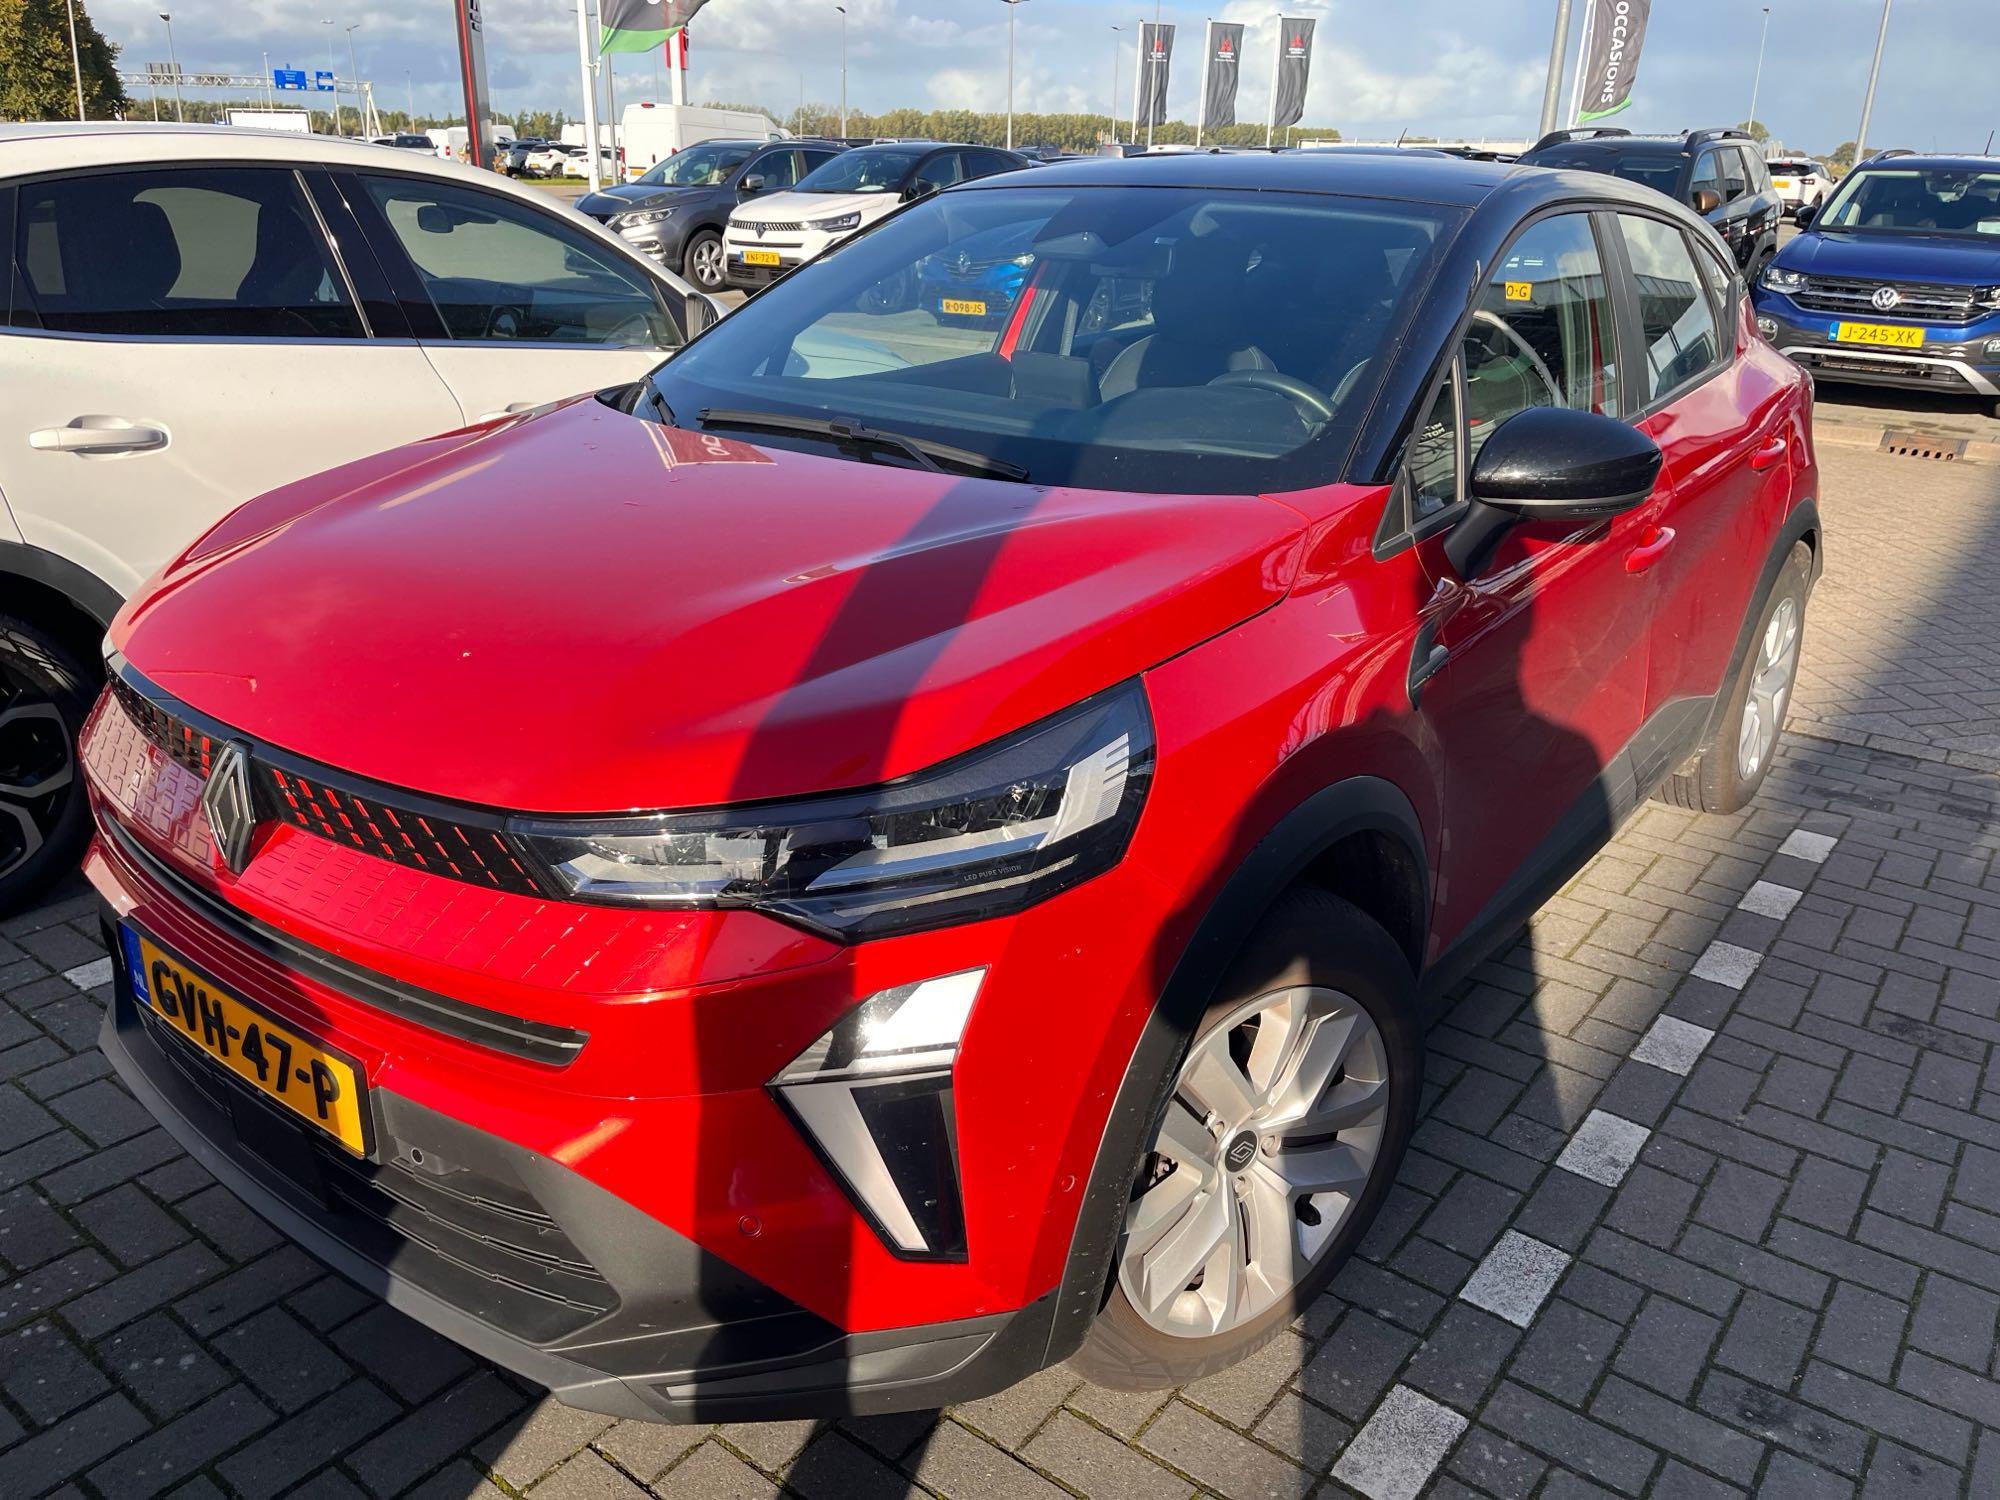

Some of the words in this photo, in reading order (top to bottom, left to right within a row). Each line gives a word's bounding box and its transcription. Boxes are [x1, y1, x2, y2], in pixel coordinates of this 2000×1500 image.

[1601, 1, 1630, 103] OCCASIONS
[944, 301, 983, 313] R-098-JS
[1844, 326, 1917, 344] J-245-XK
[963, 873, 978, 882] LED
[978, 869, 998, 879] PURE
[998, 865, 1022, 875] VISION
[151, 959, 340, 1120] GVH-47-P
